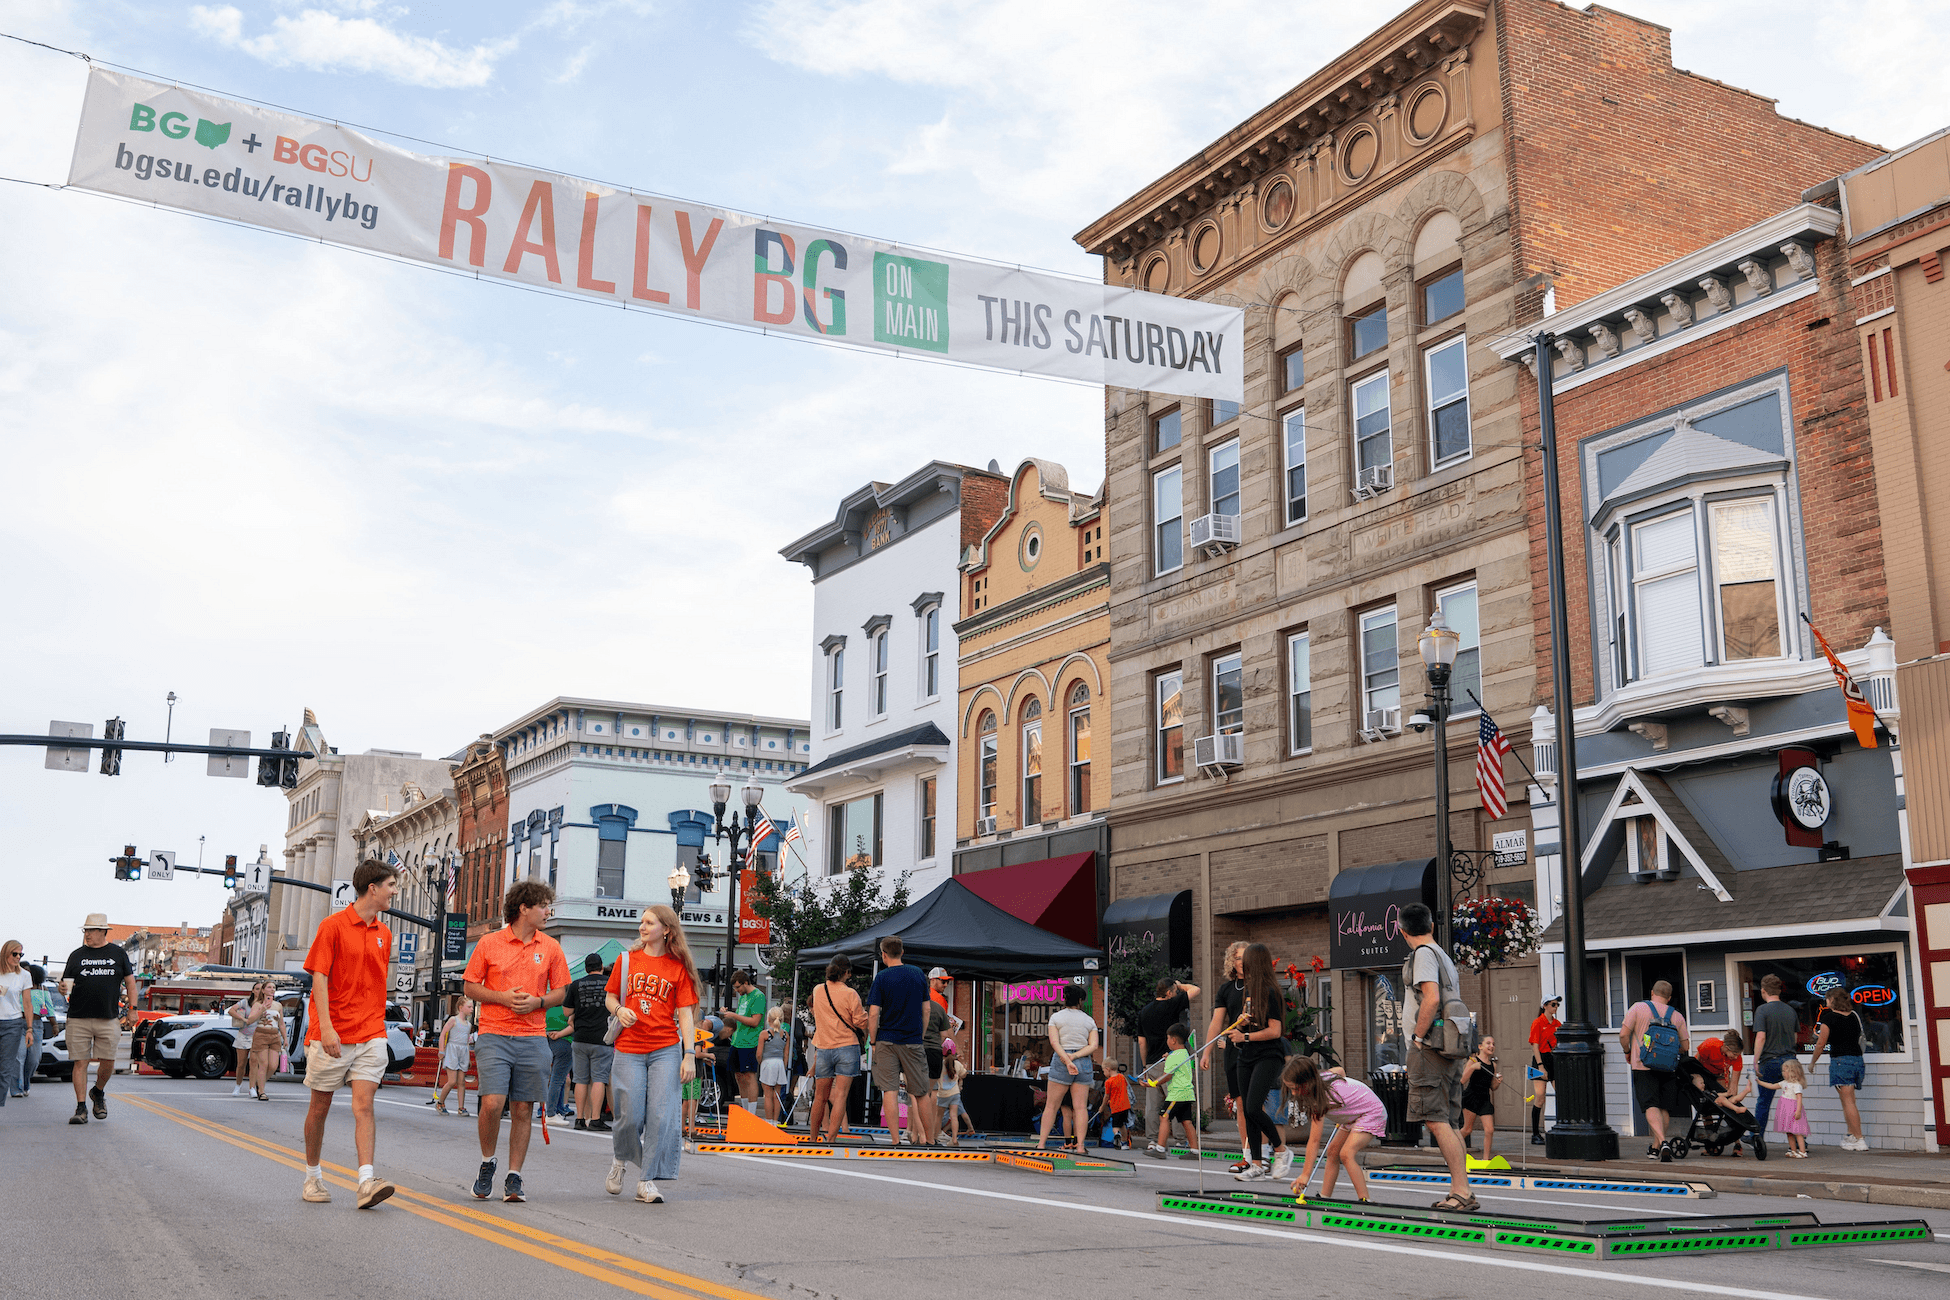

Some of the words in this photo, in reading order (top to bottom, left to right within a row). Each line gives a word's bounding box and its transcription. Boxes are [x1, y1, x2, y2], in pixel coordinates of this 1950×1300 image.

[273, 135, 374, 182] BGSU
[115, 143, 379, 230] bgsu.edu/rallybg
[438, 162, 725, 311] RALLY
[753, 228, 848, 336] BG
[885, 262, 913, 297] ON
[885, 307, 940, 342] MAIN
[978, 295, 1052, 350] THIS
[1064, 309, 1225, 374] SATURDAY
[1362, 503, 1460, 550] WHITEHEAD
[872, 531, 890, 550] BANK
[1494, 837, 1525, 849] ALMAR
[152, 870, 170, 878] ONLY
[247, 883, 265, 891] ONLY
[598, 906, 638, 919] RAYLE
[715, 914, 723, 924] &
[742, 919, 767, 930] BGSU
[1337, 910, 1383, 947] Kalifornia
[401, 934, 415, 950] H
[1371, 936, 1377, 944] &
[1360, 945, 1389, 956] SUITES
[81, 958, 107, 966] Clowns
[90, 968, 115, 976] Jokers
[397, 977, 412, 987] 64
[1816, 976, 1839, 985] BUD
[1853, 988, 1892, 1004] OPEN
[697, 1031, 701, 1040] 5
[844, 1147, 850, 1158] 5
[1520, 1178, 1525, 1189] 4
